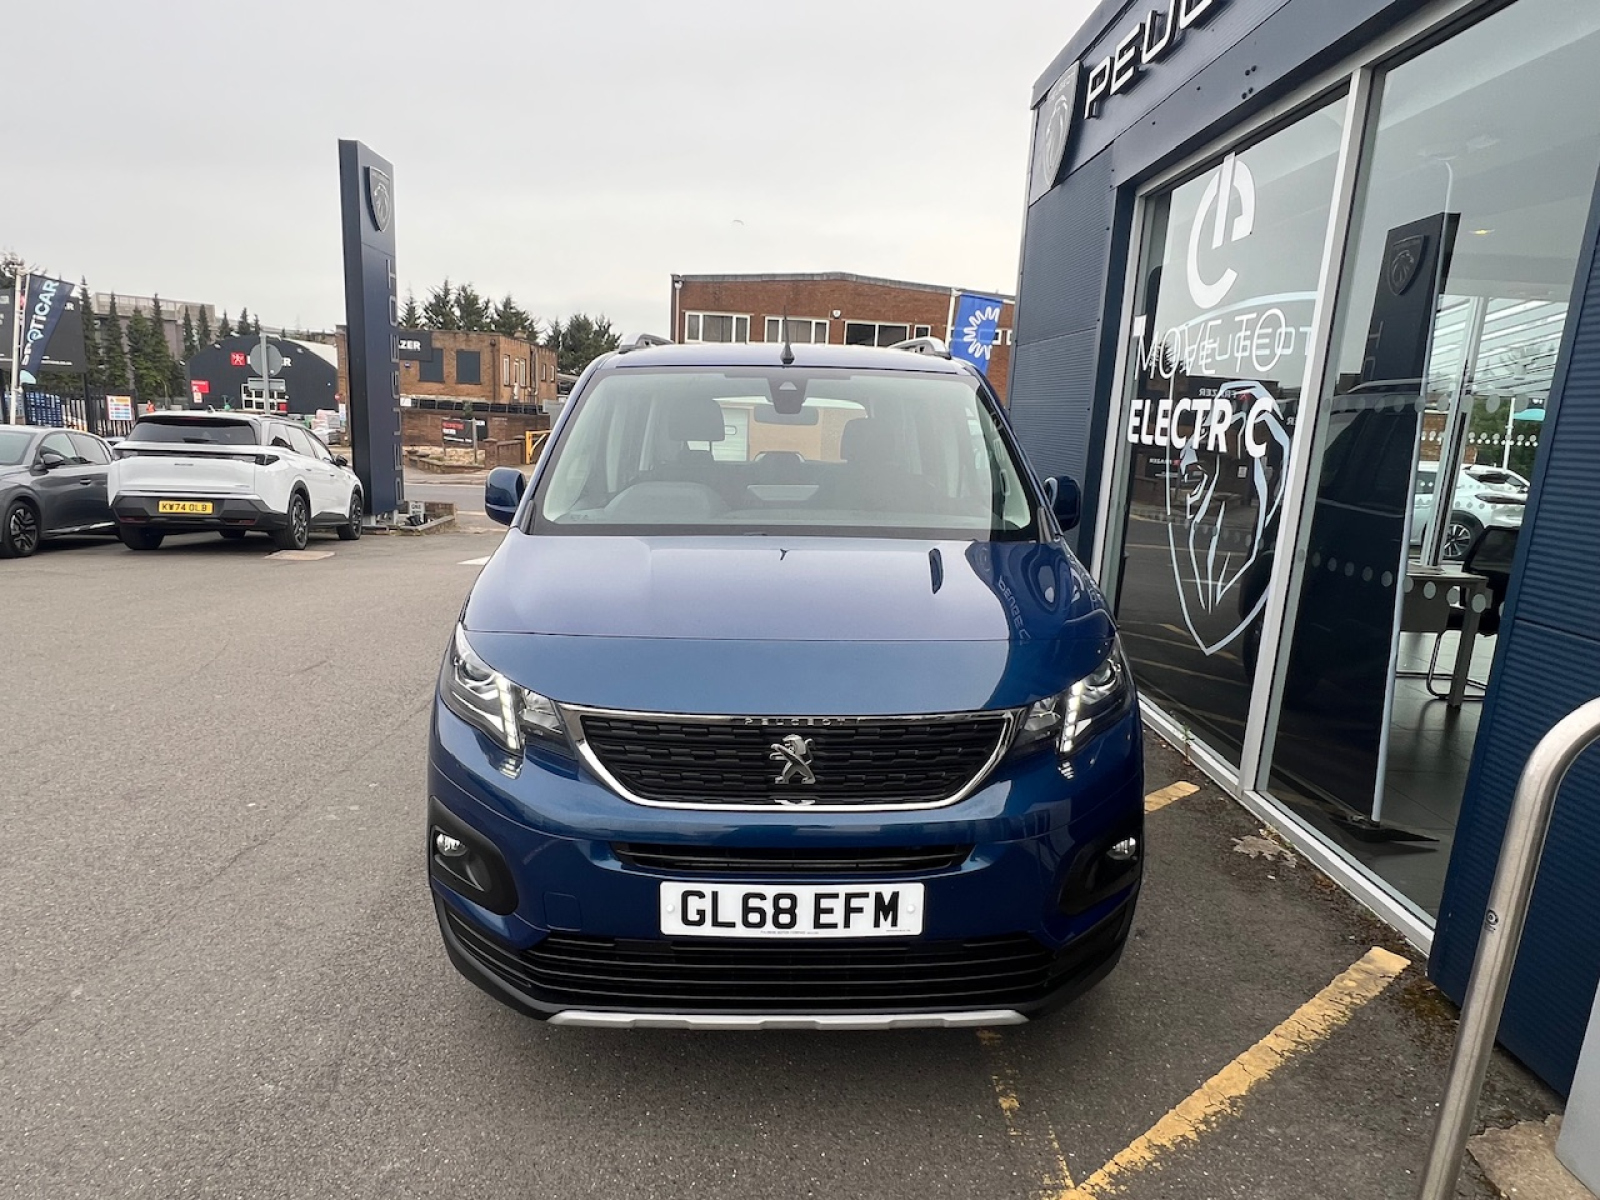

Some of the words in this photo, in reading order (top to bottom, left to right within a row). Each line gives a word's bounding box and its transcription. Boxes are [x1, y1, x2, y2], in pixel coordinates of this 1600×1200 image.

[21, 279, 60, 366] SPOTICAR
[1134, 319, 1222, 381] MOVE
[1234, 308, 1286, 373] TO
[386, 258, 405, 506] PEUGEOT
[680, 889, 798, 930] GL68
[813, 890, 900, 930] EFM
